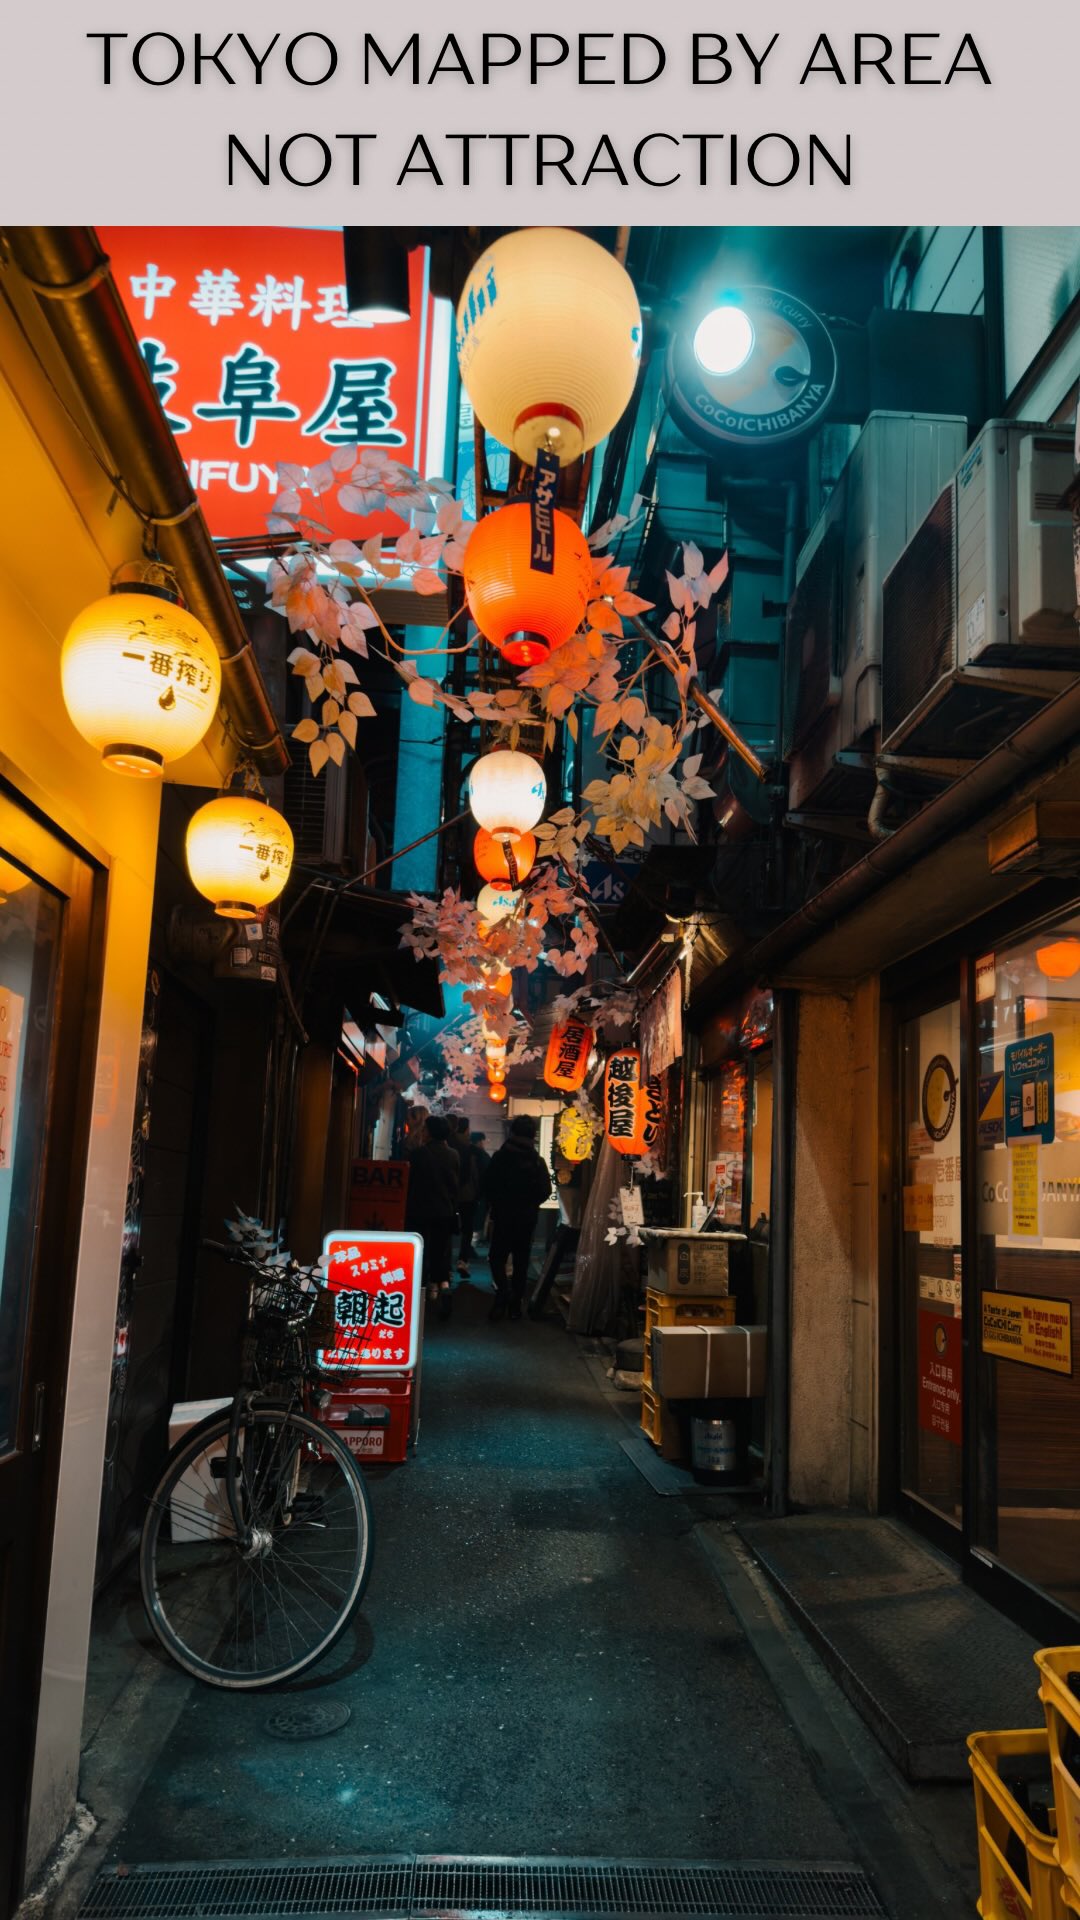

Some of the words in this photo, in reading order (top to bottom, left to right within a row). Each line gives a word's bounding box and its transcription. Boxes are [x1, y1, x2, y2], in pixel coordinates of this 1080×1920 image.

[695, 383, 826, 431] CoCoICHIBANYA
[533, 468, 557, 564] アサヒビール
[122, 650, 212, 694] 一番搾り
[553, 1025, 585, 1079] 居酒屋
[607, 1055, 638, 1139] 越後屋
[353, 1166, 403, 1186] BAR
[335, 1290, 405, 1328] 朝起
[1033, 1309, 1048, 1323] have
[1050, 1313, 1068, 1326] menu
[922, 1376, 946, 1396] Entrance
[342, 1436, 382, 1446] APPORO
